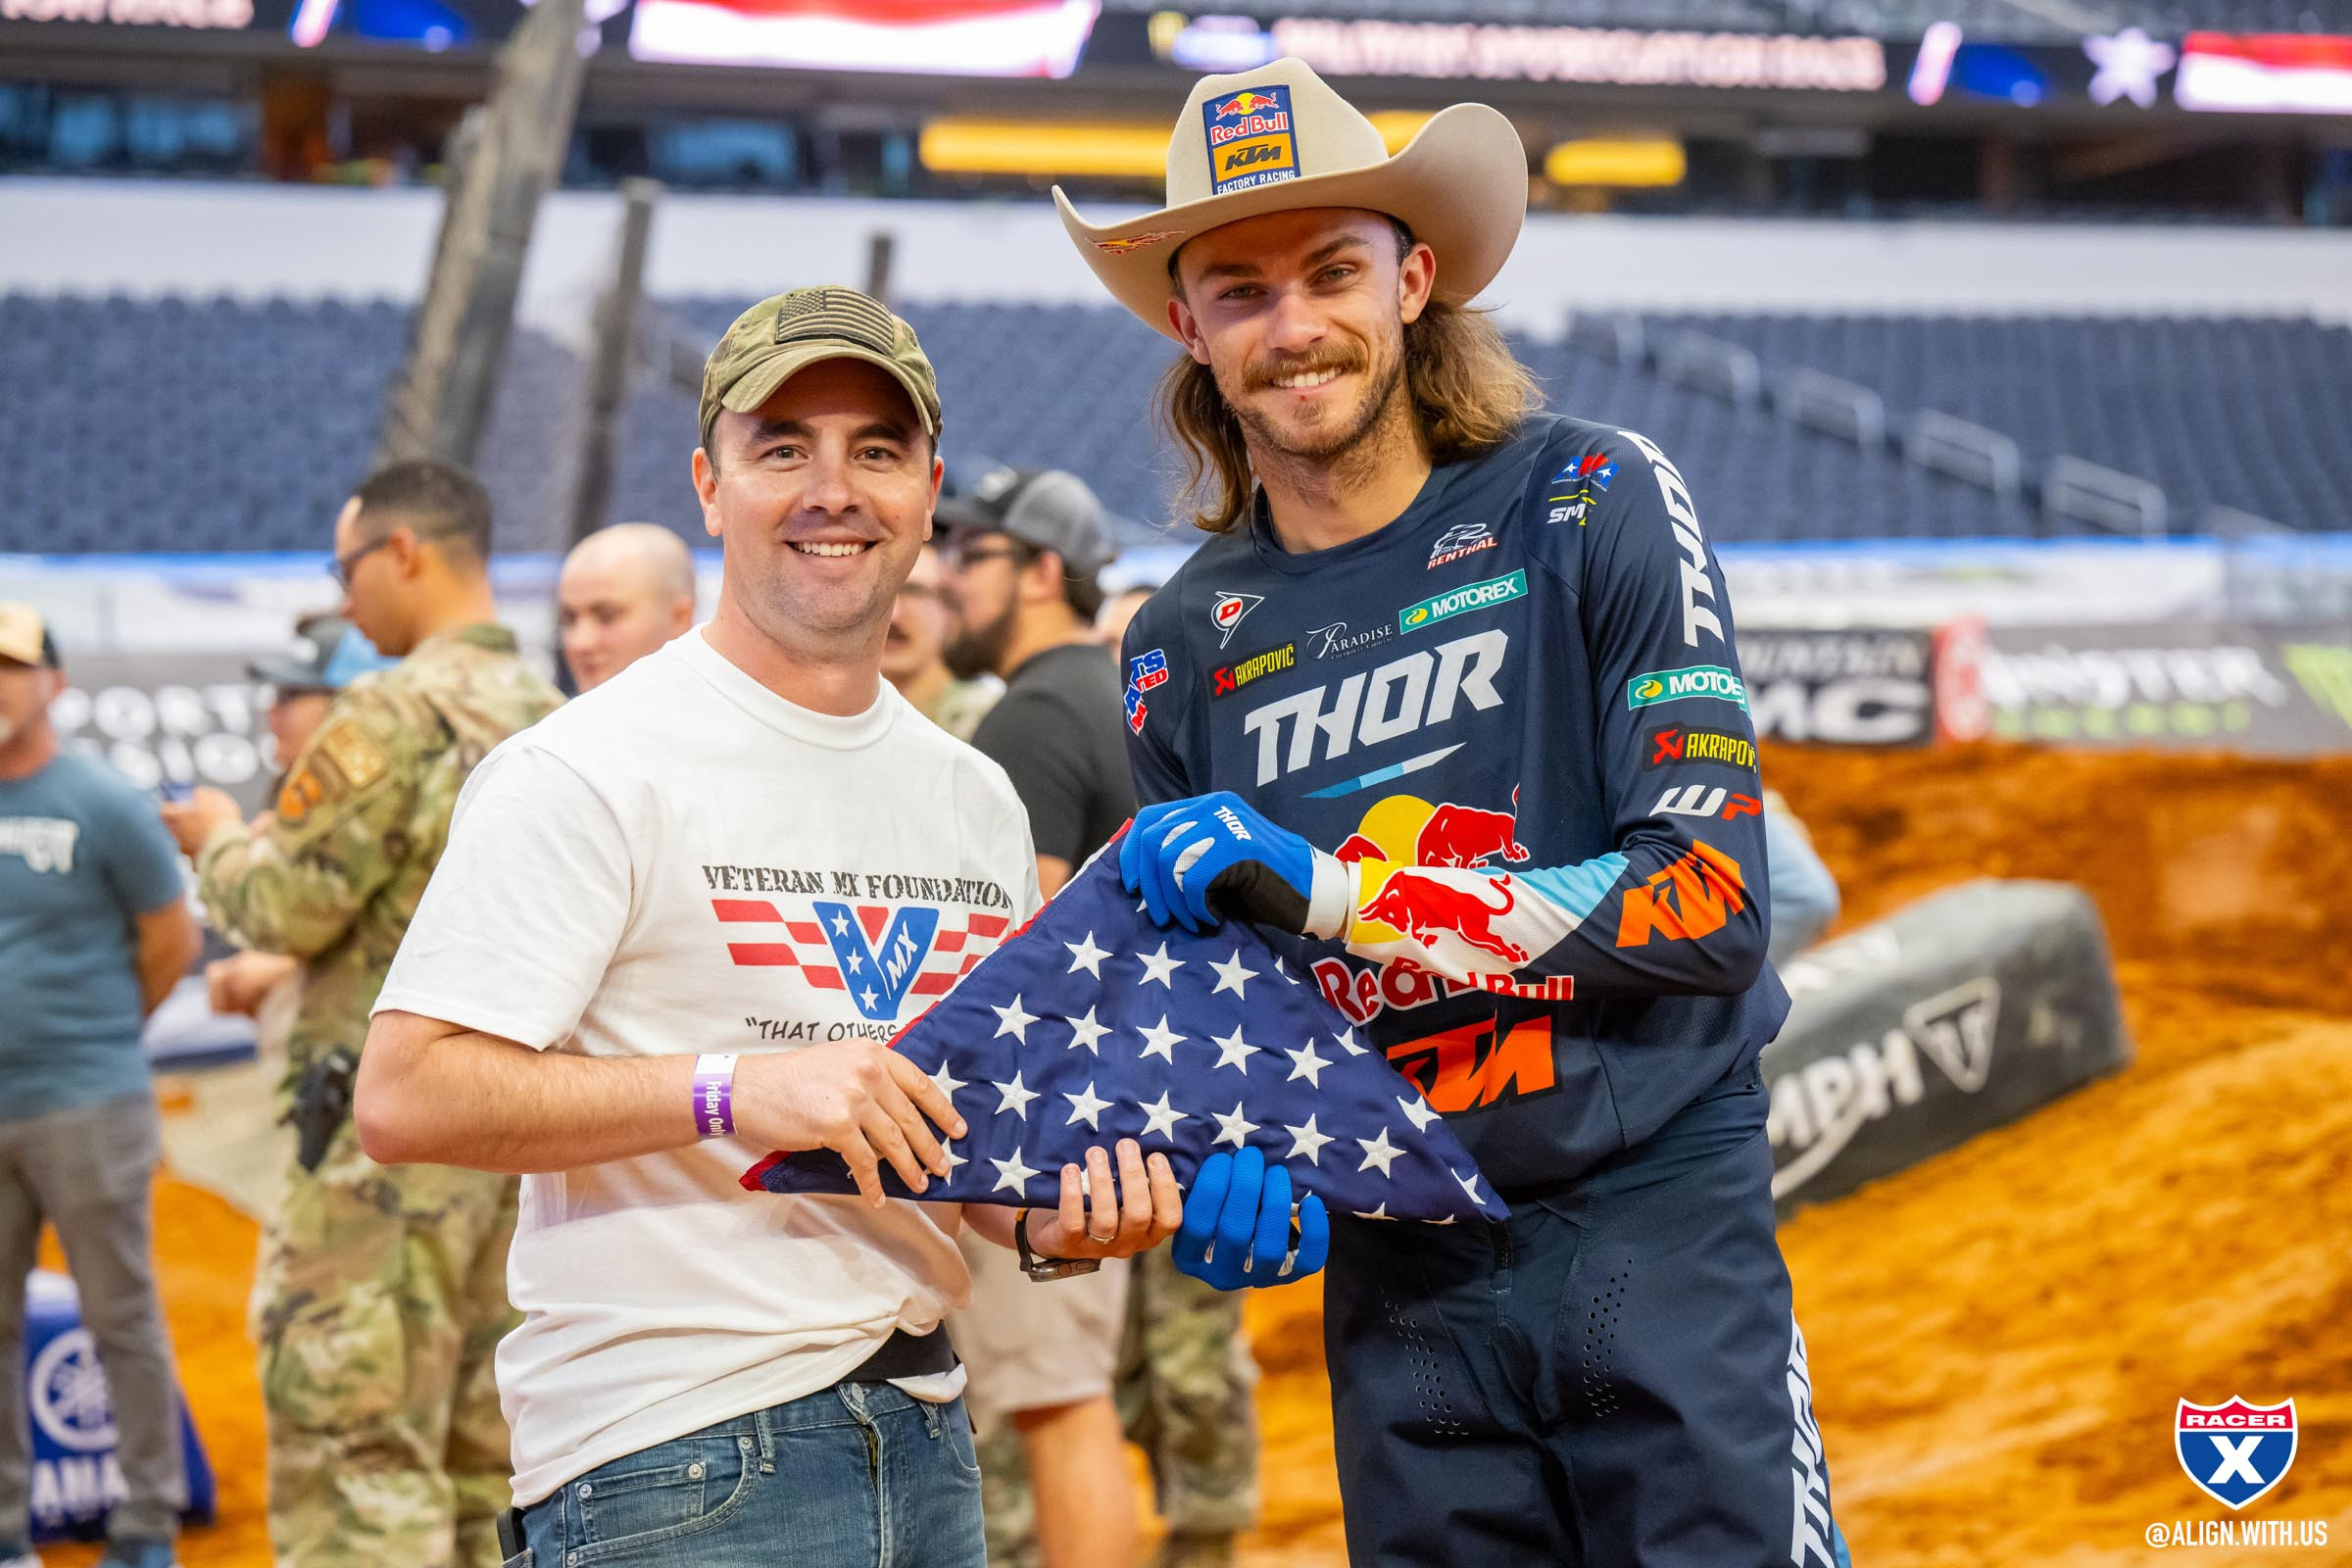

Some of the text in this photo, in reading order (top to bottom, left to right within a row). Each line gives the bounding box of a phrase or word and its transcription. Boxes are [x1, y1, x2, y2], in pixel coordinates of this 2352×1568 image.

[1210, 112, 1289, 145] Red Bull
[1225, 144, 1281, 171] KTM
[1217, 171, 1296, 195] FACTORY RACING
[1427, 537, 1497, 569] RENTHAL
[1220, 602, 1242, 620] D
[1432, 578, 1518, 617] MOTOREX
[1305, 622, 1392, 659] PARADISE
[1244, 628, 1509, 787] THOR
[1648, 784, 1762, 821] WP
[1213, 806, 1251, 841] THOR
[702, 864, 1013, 908] VETERAN MX FOUNDATION
[1616, 838, 1746, 948] KTM
[886, 919, 920, 992] MX
[745, 1016, 820, 1041] "THAT
[705, 1081, 722, 1115] Friday
